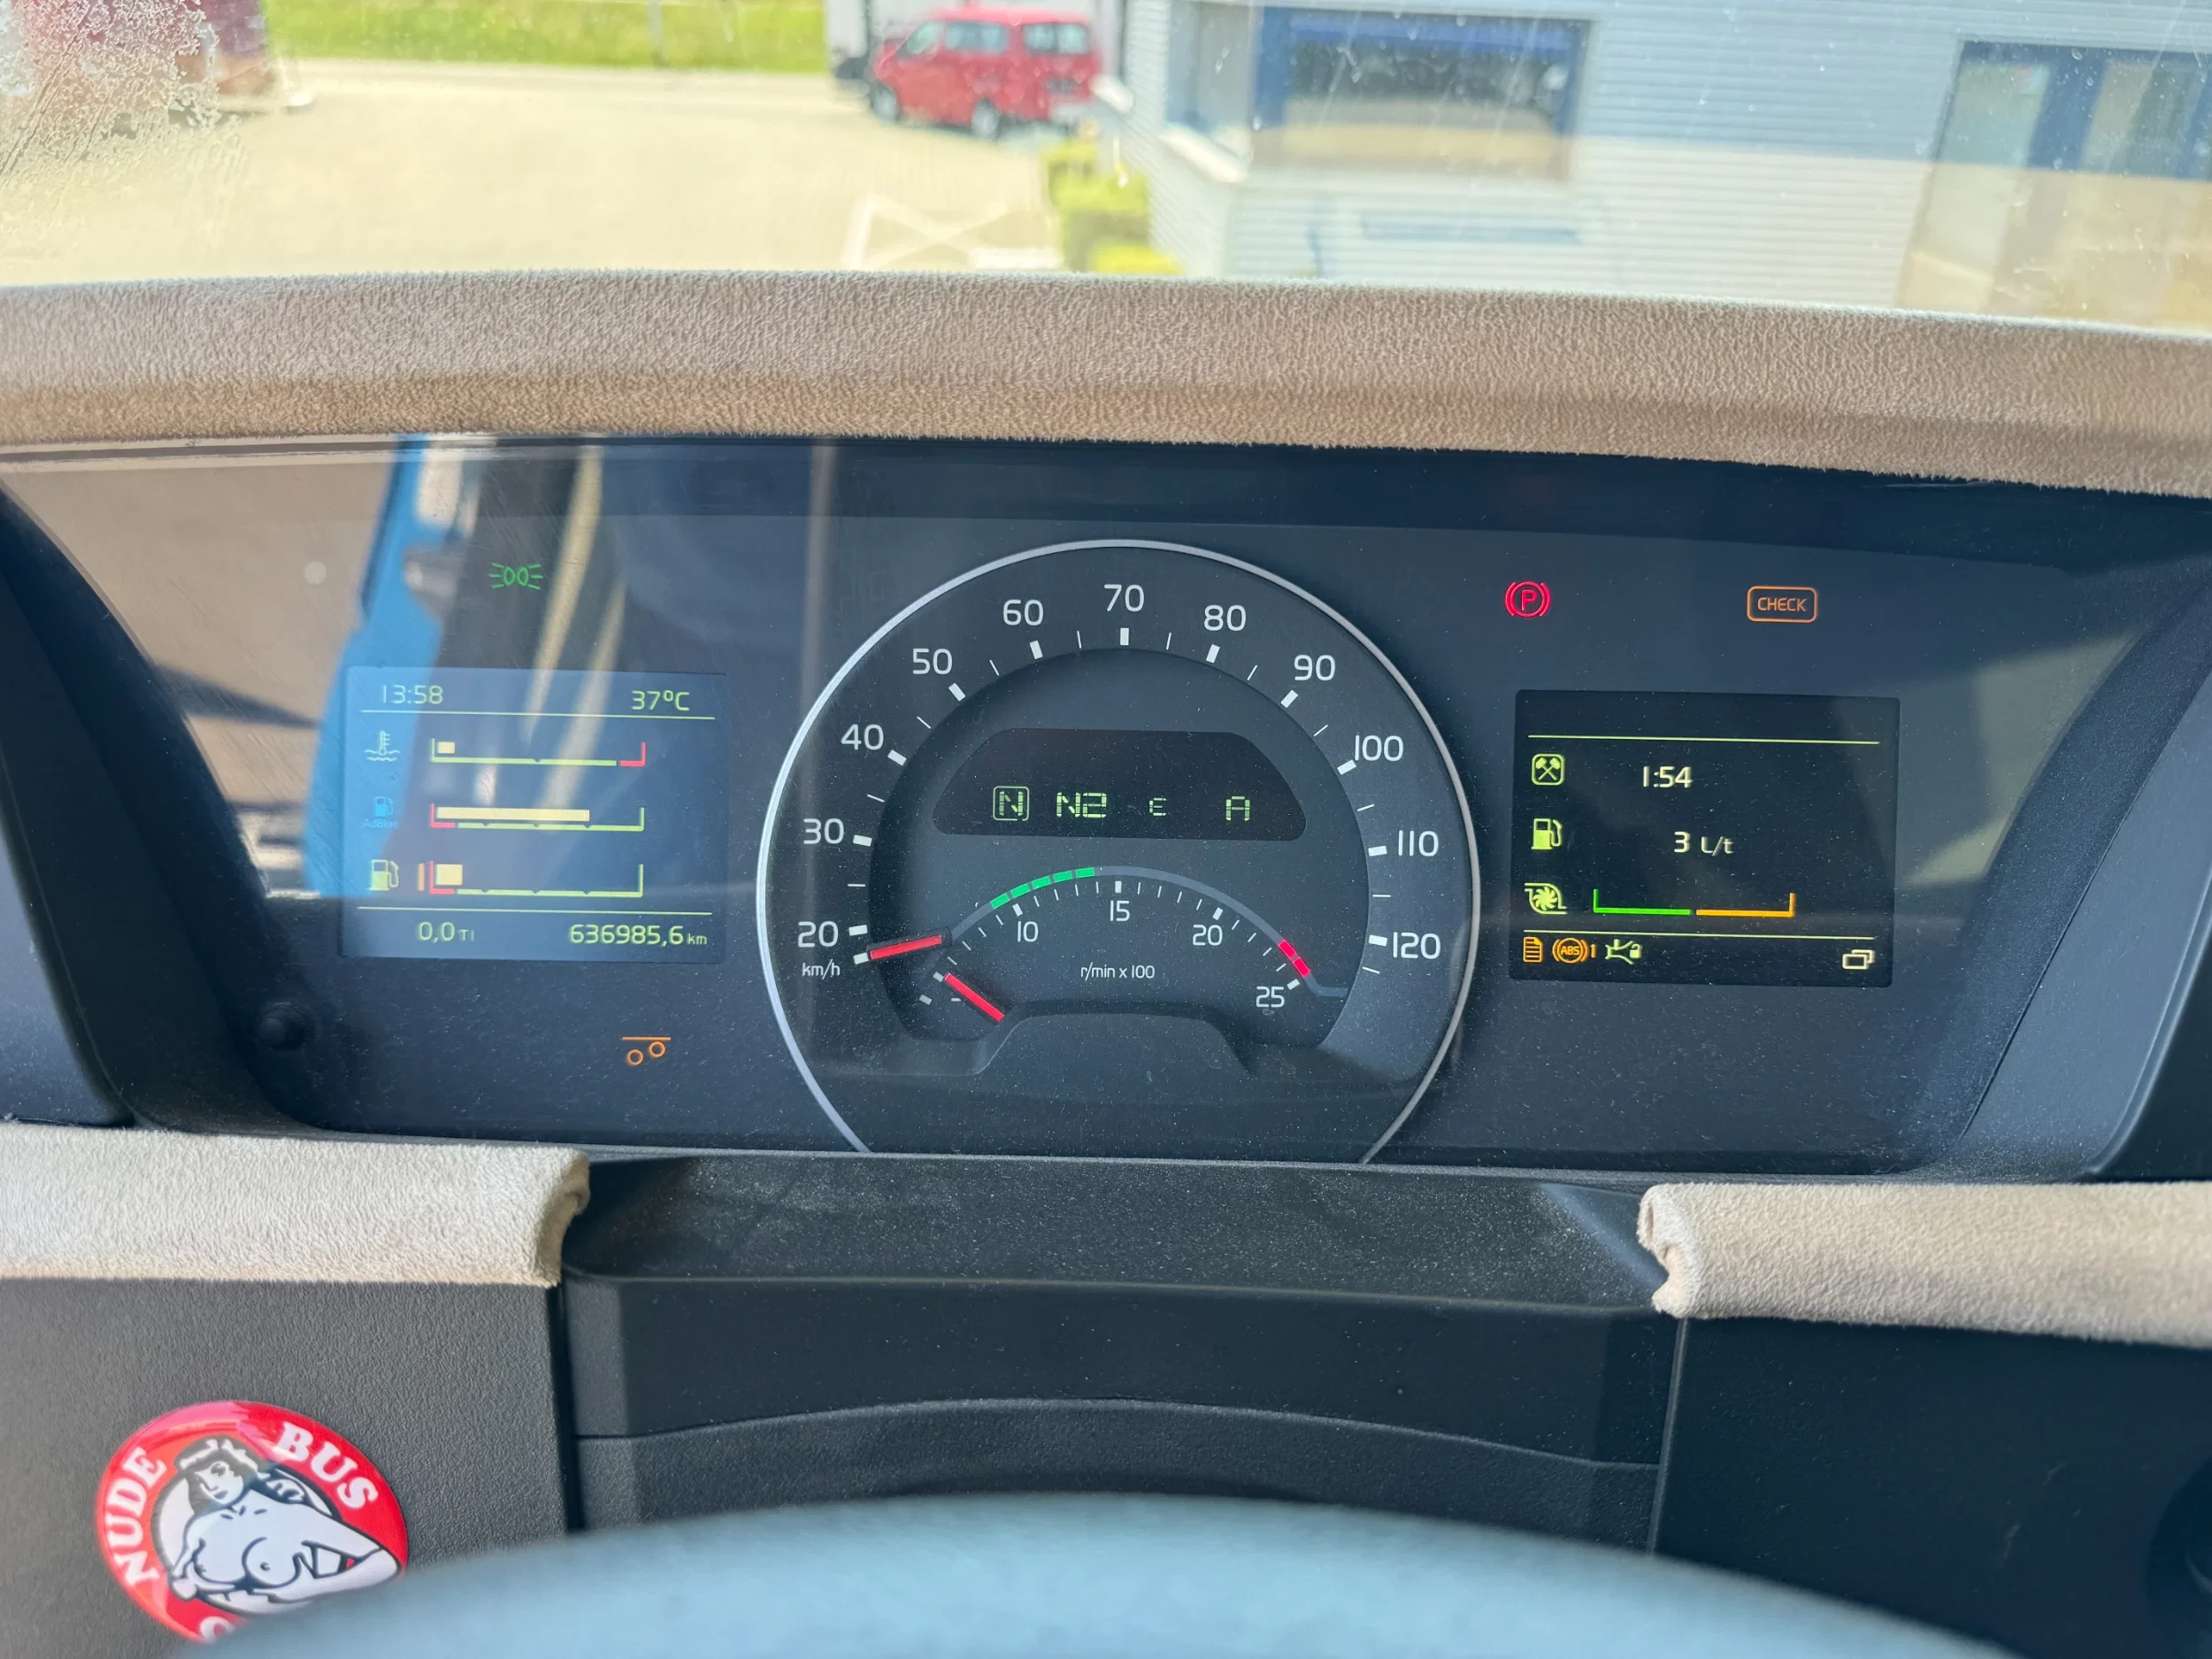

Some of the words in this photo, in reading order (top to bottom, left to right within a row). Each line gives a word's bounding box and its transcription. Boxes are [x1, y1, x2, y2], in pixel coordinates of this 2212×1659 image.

[1103, 584, 1145, 612] 70
[1521, 590, 1536, 611] P
[1757, 596, 1806, 613] CHECK
[1002, 600, 1044, 626] 60
[1203, 605, 1247, 632] 80
[911, 648, 953, 675] 50
[1293, 655, 1335, 681] 90
[380, 685, 443, 705] 13:58
[630, 690, 690, 711] 37°C
[841, 724, 884, 750] 40
[1353, 734, 1404, 762] 100
[1642, 766, 1693, 787] 1:54
[999, 791, 1024, 817] N
[1056, 792, 1107, 818] N2
[1149, 798, 1167, 817] E
[1225, 796, 1250, 821] A
[362, 818, 398, 829] AdBlue
[803, 818, 845, 845] 30
[1398, 831, 1440, 857] 110
[1673, 832, 1691, 853] 3
[1701, 837, 1734, 856] L/t
[1110, 901, 1131, 922] 15
[418, 922, 456, 942] 0,0
[569, 925, 685, 947] 636985,6
[687, 933, 708, 945] km
[796, 921, 839, 948] 20
[1017, 921, 1039, 942] 10
[1192, 925, 1223, 947] 20
[1392, 932, 1441, 960] 120
[1560, 946, 1580, 956] ABS
[802, 962, 841, 977] km/h
[1080, 962, 1116, 980] r/min
[1118, 967, 1127, 978] x
[1131, 964, 1155, 978] 100
[1256, 986, 1286, 1007] 25
[272, 1422, 379, 1509] BUS
[105, 1447, 167, 1586] NUDE
